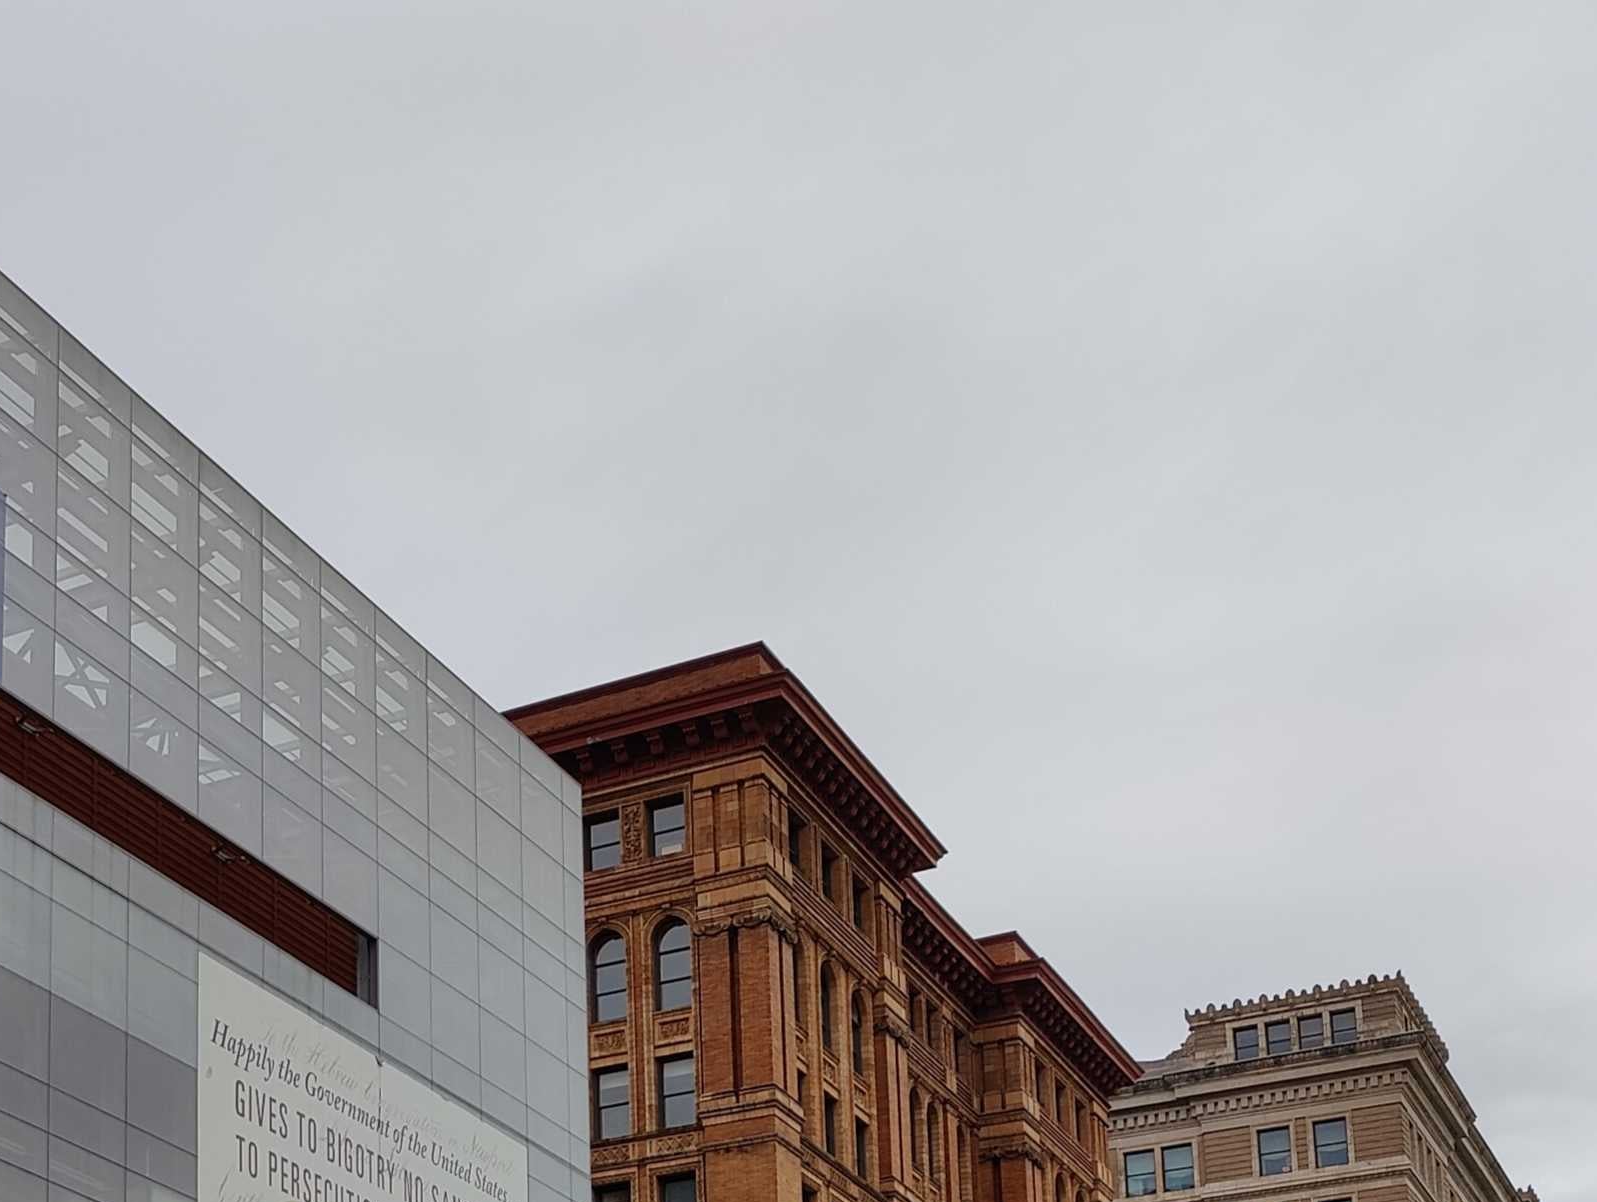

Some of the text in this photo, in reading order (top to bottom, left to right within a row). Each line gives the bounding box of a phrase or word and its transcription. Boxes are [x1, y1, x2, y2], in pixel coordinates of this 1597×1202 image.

[210, 1019, 274, 1082] Happily
[278, 1059, 301, 1088] the
[305, 1071, 390, 1139] Government
[393, 1125, 408, 1154] of
[408, 1132, 428, 1159] the
[431, 1141, 472, 1185] United
[235, 1079, 288, 1140] GIVES
[296, 1110, 317, 1154] TO
[327, 1127, 395, 1194] BIGOTRY
[236, 1134, 258, 1179] TO
